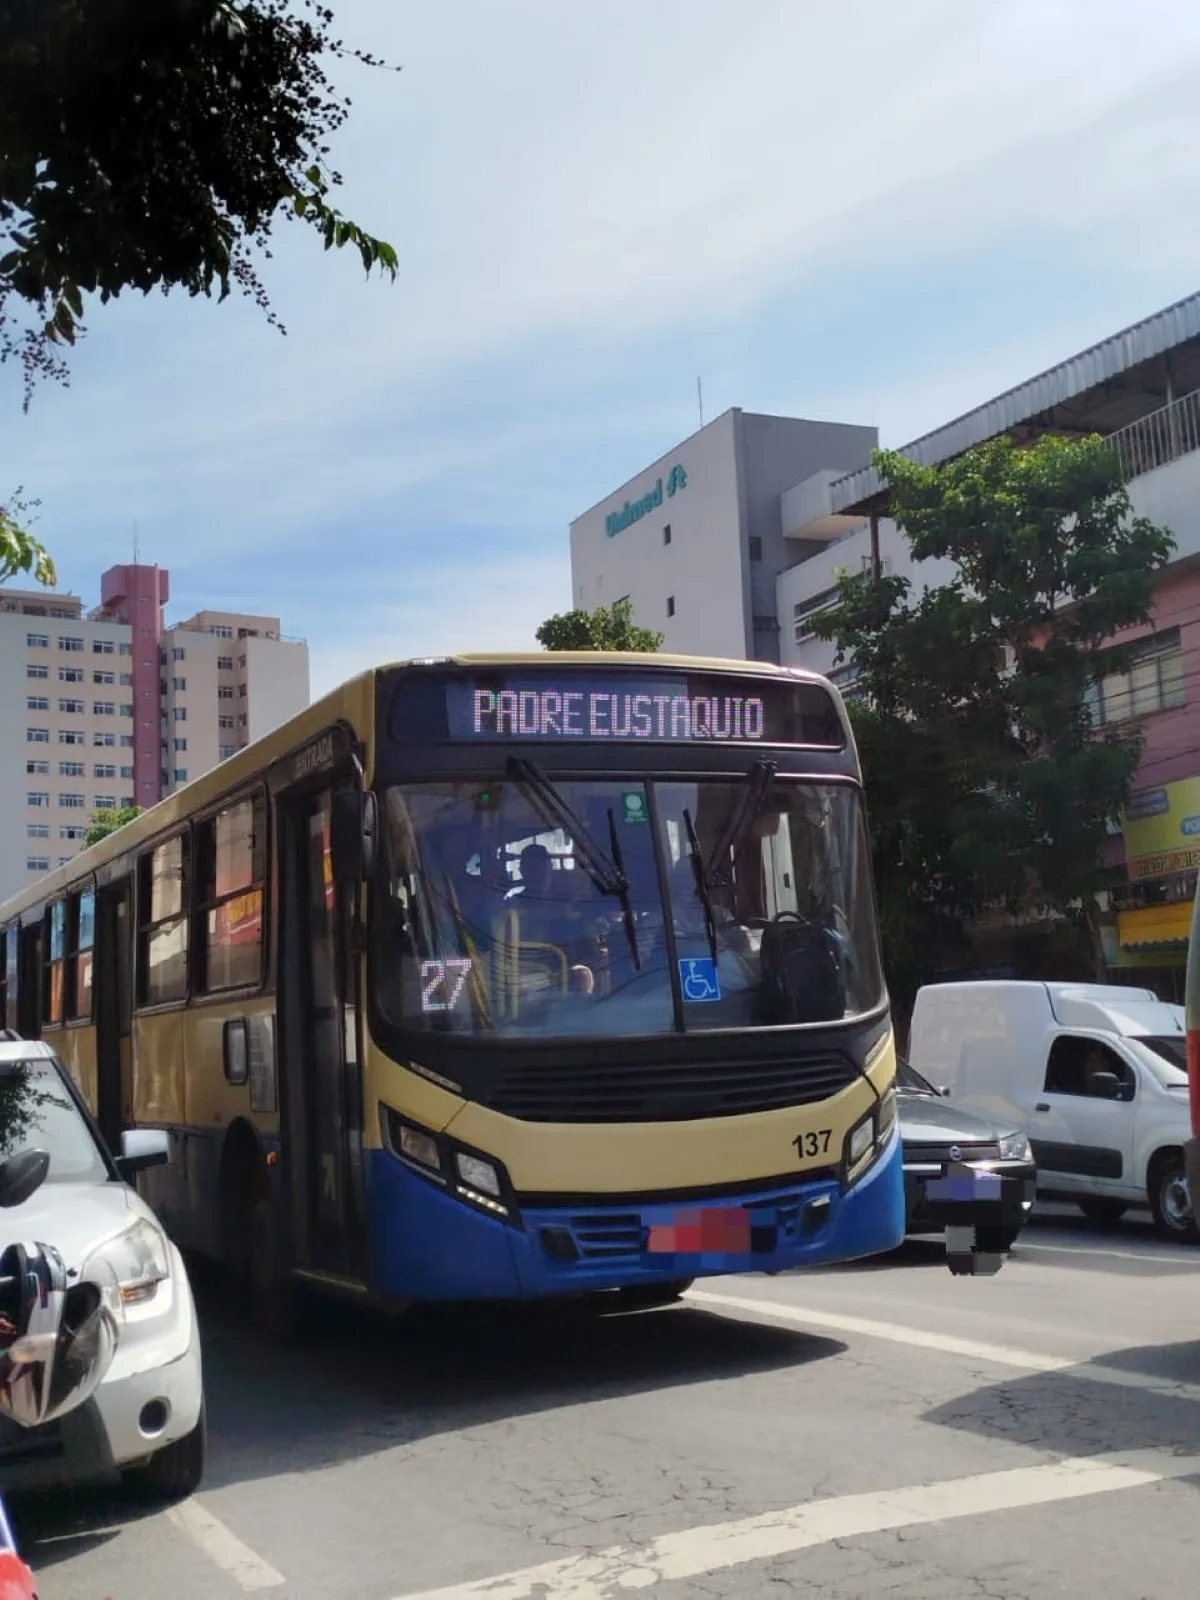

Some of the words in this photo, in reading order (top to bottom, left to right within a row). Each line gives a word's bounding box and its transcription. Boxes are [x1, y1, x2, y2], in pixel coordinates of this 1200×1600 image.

[473, 689, 583, 734] PADRE
[590, 693, 765, 738] EUSTAQUIO
[421, 959, 472, 1011] 27
[792, 1129, 832, 1158] 137
